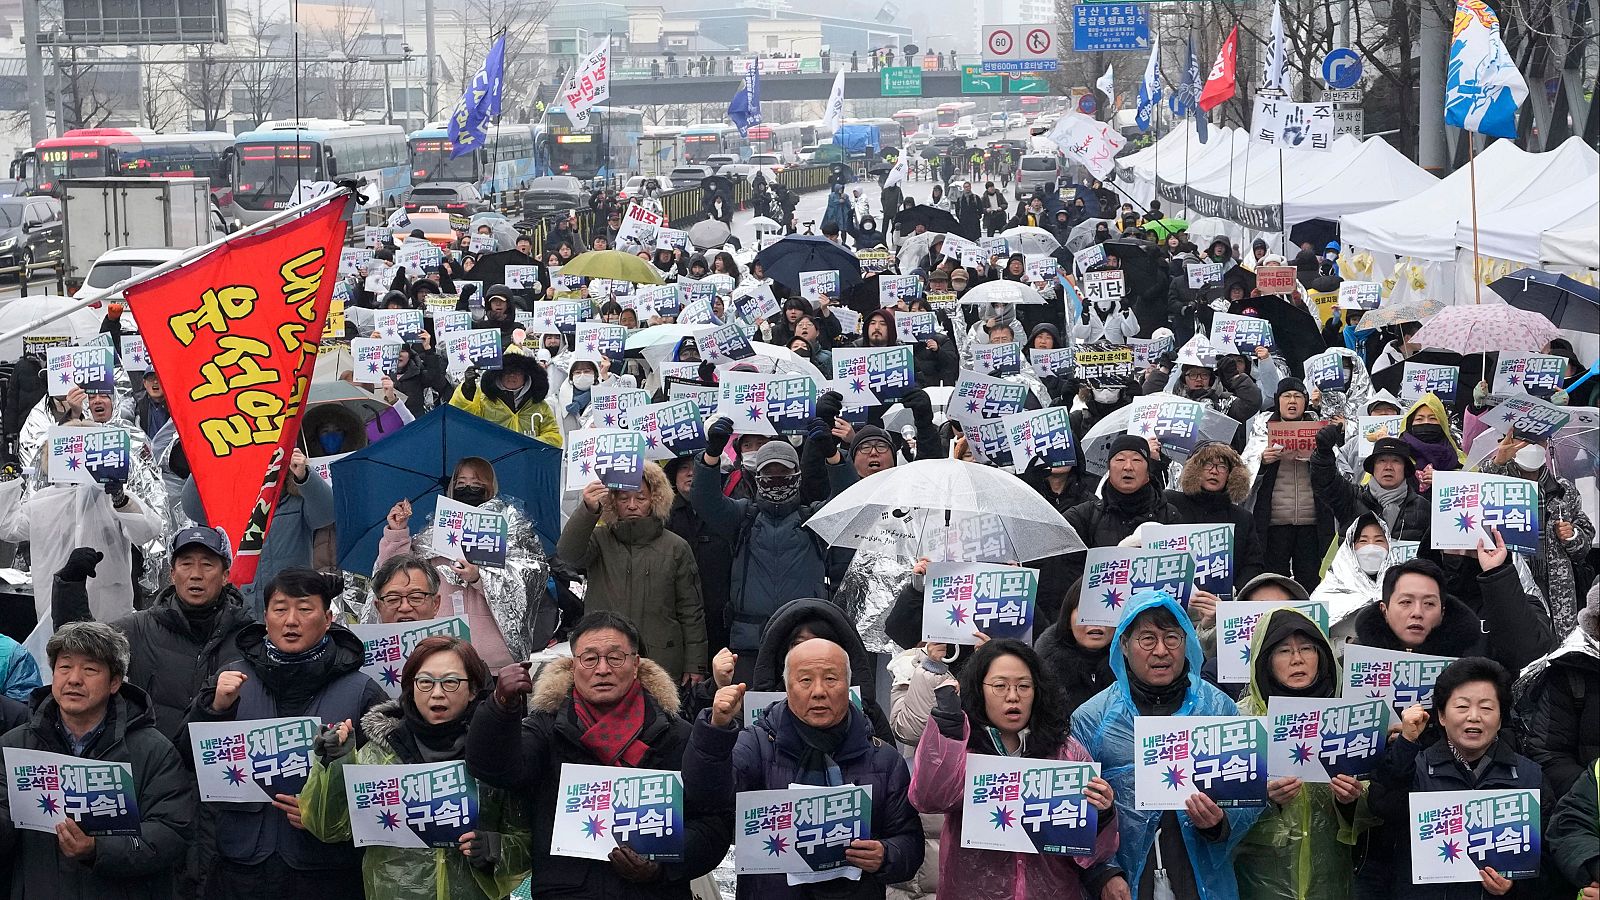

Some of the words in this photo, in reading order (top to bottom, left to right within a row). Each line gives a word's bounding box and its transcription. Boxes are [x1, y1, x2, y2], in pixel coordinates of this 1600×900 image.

[1078, 16, 1145, 26] 혼잡통행료징수
[995, 38, 1006, 47] 60
[1334, 112, 1361, 122] 색차선
[1334, 126, 1361, 136] 스전용
[42, 151, 68, 162] 4103
[629, 204, 660, 224] 체포
[653, 287, 675, 299] 체포!
[1088, 281, 1122, 299] 처단
[1357, 283, 1379, 294] 체포!
[555, 301, 577, 314] 체포!
[654, 297, 676, 310] 구속!
[1357, 293, 1379, 304] 구속!
[396, 310, 420, 325] 체포!
[555, 314, 578, 326] 구속!
[911, 314, 932, 325] 체포!
[1235, 319, 1264, 333] 체포!
[397, 322, 420, 335] 구속!
[599, 327, 622, 340] 체포!
[714, 323, 740, 346] 체포!
[912, 324, 933, 335] 구속!
[467, 329, 498, 347] 체포!
[720, 336, 747, 355] 구속!
[1235, 332, 1263, 346] 구속!
[73, 347, 106, 369] 해체
[358, 345, 382, 354] 내란수괴
[358, 351, 381, 361] 윤석열
[468, 344, 498, 362] 구속!
[599, 340, 622, 358] 구속!
[992, 343, 1016, 358] 체포!
[1050, 349, 1073, 362] 체포!
[1079, 354, 1106, 363] 내란수괴
[1107, 352, 1128, 361] 윤석열
[838, 356, 866, 371] 내란수괴
[868, 348, 908, 375] 체포!
[992, 354, 1017, 369] 구속!
[1051, 357, 1073, 373] 구속!
[1313, 352, 1338, 370] 체포!
[1501, 358, 1527, 368] 내란수괴
[1501, 364, 1526, 374] 윤석열
[1526, 357, 1563, 374] 체포!
[73, 366, 106, 385] 하라
[838, 364, 866, 379] 윤석열
[868, 368, 909, 391] 구속!
[1314, 368, 1340, 385] 구속!
[1426, 367, 1454, 382] 체포!
[734, 381, 767, 396] 내란수괴
[766, 377, 812, 401] 체포!
[961, 380, 989, 393] 내란수괴
[1426, 380, 1453, 394] 구속!
[1524, 372, 1558, 390] 구속!
[593, 393, 617, 404] 내란동조
[734, 391, 766, 406] 윤석열
[959, 387, 985, 399] 윤석열
[984, 383, 1022, 403] 체포!
[593, 400, 617, 411] 국민의힘
[766, 397, 811, 421] 구속!
[1134, 402, 1160, 415] 내란수괴
[1157, 400, 1199, 421] 체포!
[632, 412, 656, 426] 내란수괴
[655, 402, 695, 428] 체포!
[1031, 409, 1068, 436] 체포!
[1133, 410, 1159, 424] 윤석열
[1010, 419, 1032, 437] 내란수괴
[1155, 418, 1195, 439] 구속!
[1271, 429, 1296, 438] 내란동조
[1516, 415, 1550, 437] 하라
[54, 434, 84, 446] 내란수괴
[84, 429, 125, 451] 체포!
[571, 436, 597, 451] 내란수괴
[594, 431, 639, 455] 체포!
[661, 422, 699, 449] 구속!
[1013, 429, 1032, 446] 윤석열
[54, 442, 84, 455] 윤석열
[571, 445, 596, 463] 윤석열
[1034, 432, 1071, 458] 구속!
[85, 449, 125, 471] 구속!
[594, 451, 637, 475] 구속!
[1439, 483, 1480, 499] 내란수괴
[1480, 480, 1532, 508] 체포!
[1438, 494, 1479, 513] 윤석열
[438, 515, 463, 530] 윤석열
[440, 508, 464, 521] 내란수괴
[462, 510, 502, 532] 체포!
[1480, 506, 1532, 534] 구속!
[461, 530, 501, 554] 구속!
[1147, 535, 1188, 552] 내란수괴
[1188, 524, 1231, 554] 체포!
[1089, 558, 1131, 575] 내란수괴
[1130, 551, 1188, 583] 체포!
[931, 573, 975, 588] 내란수괴
[973, 568, 1030, 599] 체포!
[1087, 569, 1129, 588] 윤석열
[930, 584, 974, 603] 윤석열
[973, 598, 1027, 628] 구속!
[362, 645, 401, 668] 윤석열
[1350, 660, 1393, 675] 내란수괴
[1350, 671, 1392, 689] 윤석열
[1273, 708, 1321, 729] 내란수괴
[1318, 699, 1386, 738] 체포!
[247, 720, 314, 757] 체포!
[1141, 728, 1190, 749] 내란수괴
[1191, 719, 1258, 757] 체포!
[1272, 721, 1320, 743] 윤석열
[199, 732, 246, 752] 내란수괴
[1318, 730, 1378, 766] 구속!
[200, 747, 248, 766] 윤석열
[1141, 740, 1190, 767] 윤석열
[13, 763, 59, 779] 내란수괴
[60, 763, 123, 796] 체포!
[972, 770, 1021, 789] 내란수괴
[1192, 752, 1258, 791] 구속!
[15, 774, 60, 792] 윤석열
[353, 777, 400, 796] 내란수괴
[400, 762, 467, 804] 체포!
[566, 779, 612, 797] 내란수괴
[1020, 762, 1091, 801] 체포!
[355, 790, 401, 811] 윤석열
[611, 774, 673, 811] 체포!
[971, 784, 1020, 806] 윤석열
[64, 792, 128, 824] 구속!
[564, 792, 612, 815] 윤석열
[743, 799, 792, 823] 내란수괴
[793, 786, 863, 830] 체포!
[1417, 802, 1463, 823] 내란수괴
[1464, 793, 1531, 832] 체포!
[405, 795, 471, 834] 구속!
[1021, 797, 1089, 834] 구속!
[611, 806, 674, 844] 구속!
[743, 812, 793, 837] 윤석열
[1417, 817, 1464, 843] 윤석열
[794, 817, 862, 857] 구속!
[1465, 824, 1532, 864] 구속!
